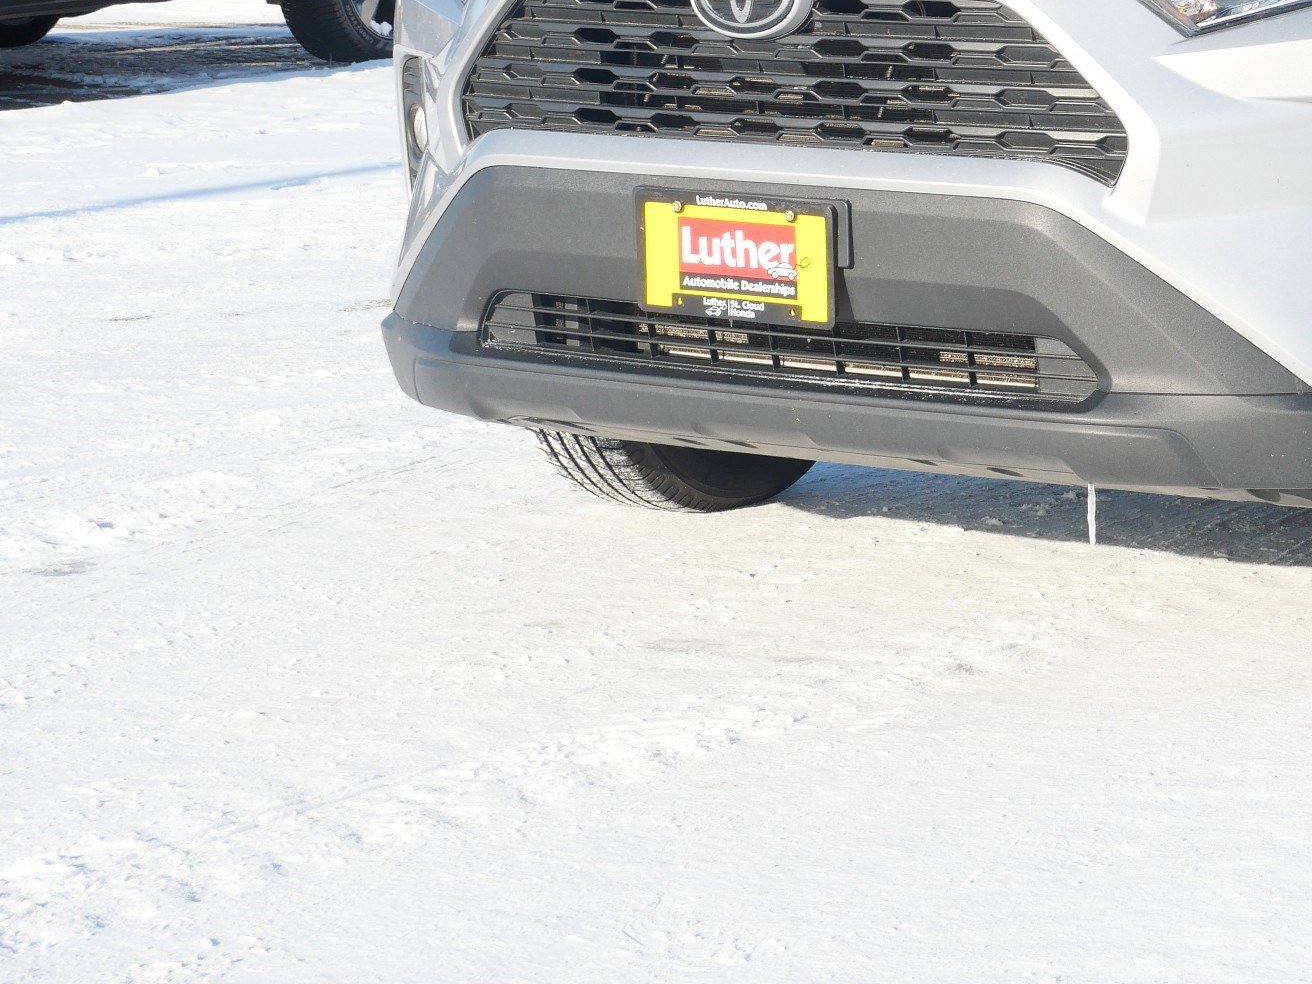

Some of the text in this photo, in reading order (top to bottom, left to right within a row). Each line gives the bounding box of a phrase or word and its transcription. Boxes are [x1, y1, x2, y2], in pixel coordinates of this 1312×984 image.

[696, 195, 767, 210] LutherAuto.com
[682, 226, 794, 268] Luther
[683, 276, 795, 296] Automobile Dealerships
[703, 297, 726, 307] Luther
[730, 300, 764, 311] St. Cloud
[730, 309, 755, 318] Honda
